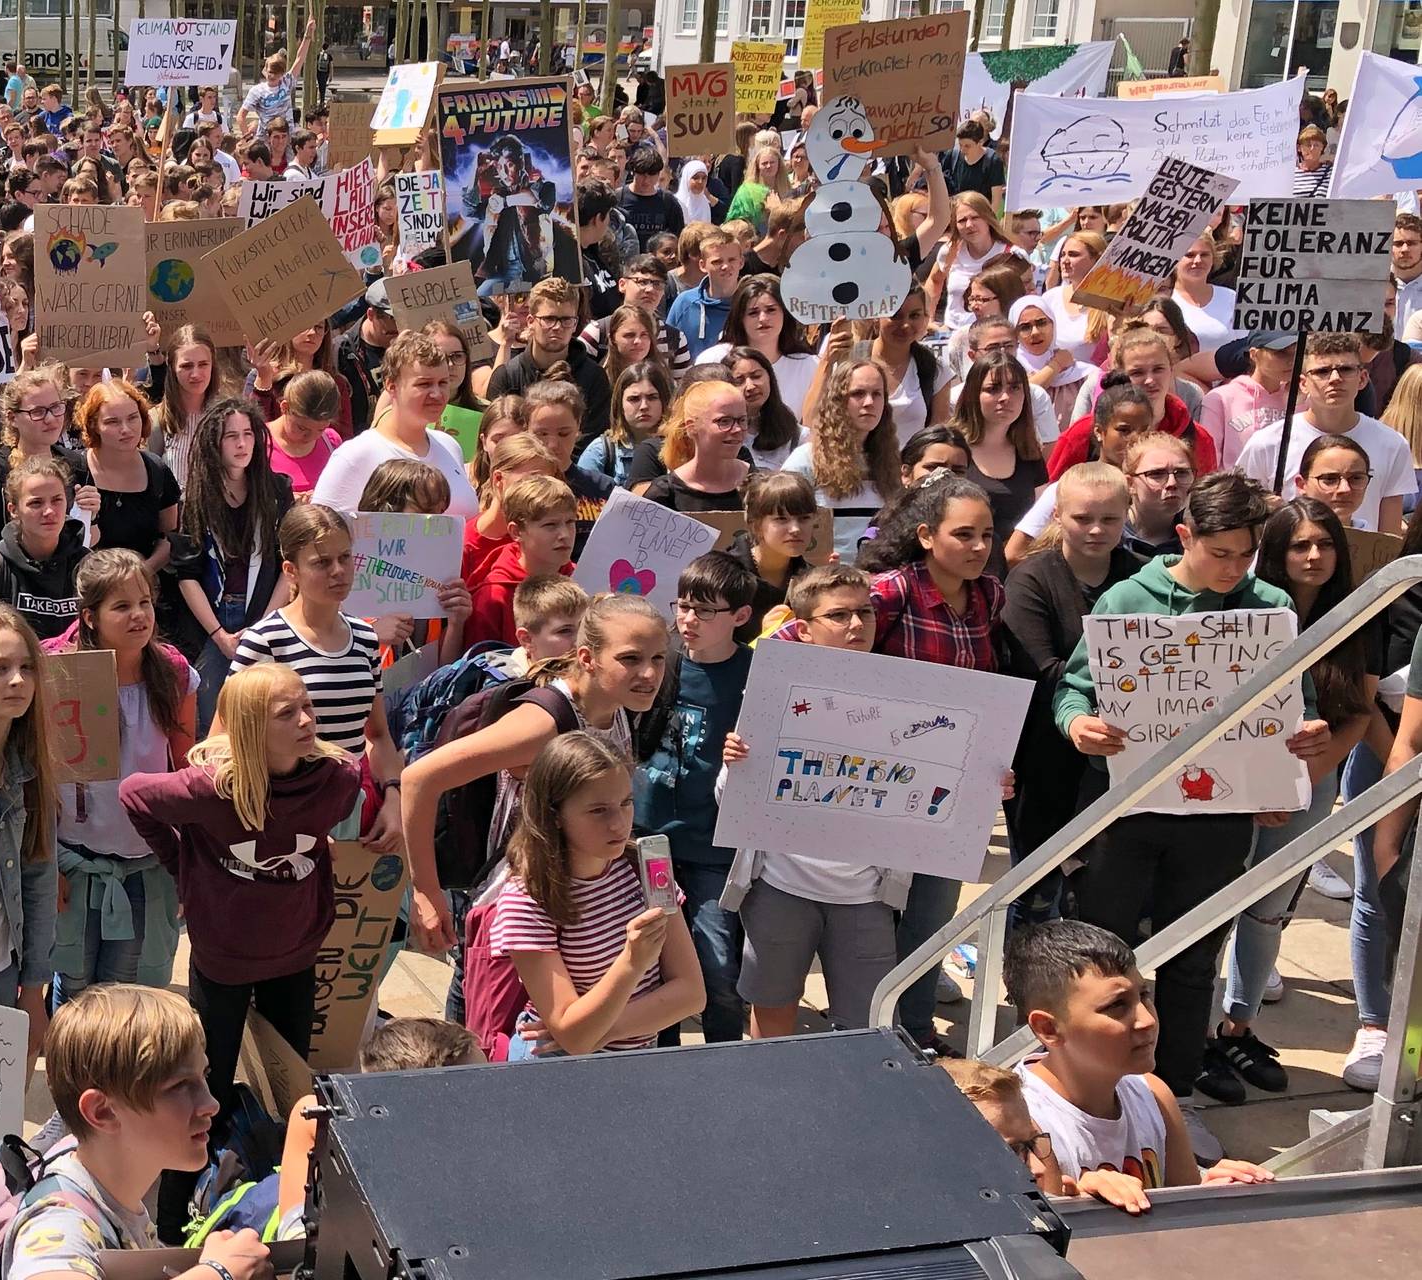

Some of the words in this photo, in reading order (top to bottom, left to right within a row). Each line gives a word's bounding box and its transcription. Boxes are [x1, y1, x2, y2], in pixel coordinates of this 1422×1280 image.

[138, 21, 231, 37] KLIMANOTSTAND
[835, 22, 951, 60] Fehlstunden
[175, 40, 194, 52] FÜR
[672, 70, 727, 97] MVG
[735, 75, 753, 85] NUR
[441, 89, 529, 115] FRIDAYS
[682, 97, 718, 109] statt
[865, 94, 947, 118] awandel
[443, 115, 466, 145] 4
[469, 106, 564, 134] FUTURE
[673, 111, 723, 138] SUV
[1153, 111, 1222, 133] Schmilzt
[1229, 111, 1250, 129] das
[1192, 134, 1208, 145] es
[1227, 129, 1254, 143] keine
[336, 161, 371, 192] HIER
[398, 176, 419, 192] DIE
[423, 174, 440, 190] JA
[1158, 157, 1215, 191] LEUTE
[252, 183, 282, 202] Wir
[291, 180, 325, 200] sind
[1148, 178, 1223, 214] GESTERN
[47, 207, 115, 235] SCHADE
[1134, 197, 1196, 231] MACHEN
[1247, 202, 1329, 226] KEINE
[1119, 215, 1184, 250] POLITIK
[1247, 229, 1392, 254] TOLERANZ
[1113, 246, 1179, 279] MORGEN
[1241, 253, 1296, 278] FÜR
[91, 284, 145, 313] GERNE
[401, 278, 462, 308] EISPOLE
[1236, 282, 1319, 306] KLIMA
[789, 296, 850, 321] RETTET
[858, 295, 898, 319] OLAF
[1233, 309, 1373, 332] IGNORANZ
[664, 508, 678, 533] IS
[680, 522, 709, 544] NO
[378, 538, 406, 556] WIR
[629, 522, 692, 560] PLANET
[634, 549, 648, 570] B
[1096, 617, 1173, 640] THIS
[1098, 646, 1125, 668] IS
[1097, 669, 1212, 692] HOTTER
[1098, 699, 1132, 717] MY
[778, 749, 866, 780] THERE
[886, 762, 916, 784] NO
[775, 779, 888, 809] PLANET
[337, 906, 392, 1001] WELT
